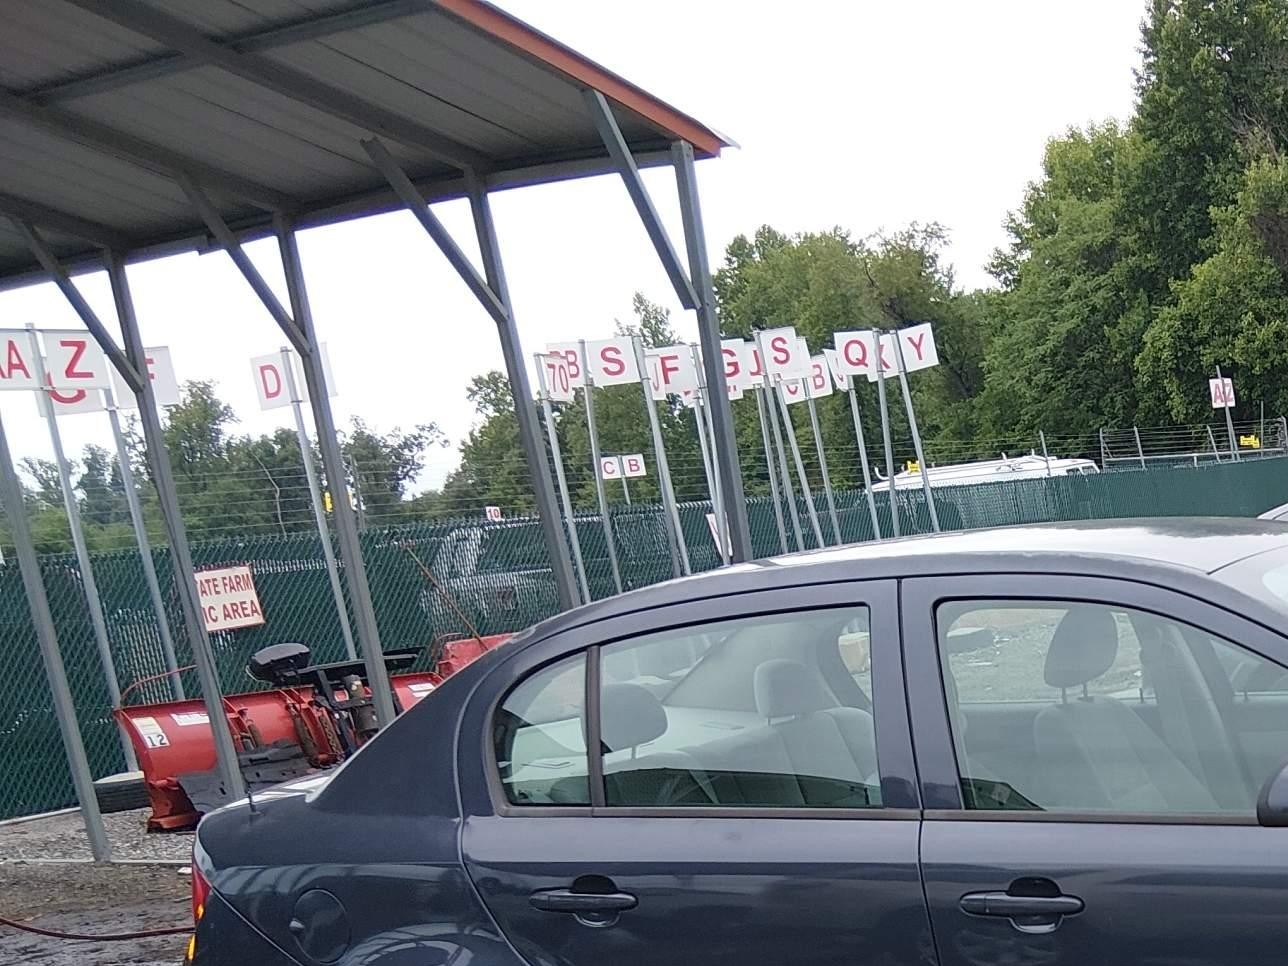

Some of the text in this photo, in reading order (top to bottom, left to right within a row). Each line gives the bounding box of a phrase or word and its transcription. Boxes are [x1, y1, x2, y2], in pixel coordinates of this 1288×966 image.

[0, 340, 31, 379] A
[60, 340, 94, 378] Z
[771, 337, 790, 365] S
[844, 339, 868, 368] Q
[907, 333, 924, 360] Y
[600, 347, 625, 376] S
[660, 355, 679, 384] F
[721, 349, 740, 377] G
[259, 364, 281, 399] D
[603, 461, 615, 475] C
[628, 458, 640, 472] B
[487, 508, 500, 519] 10
[221, 573, 253, 593] FARM
[222, 599, 261, 621] AREA
